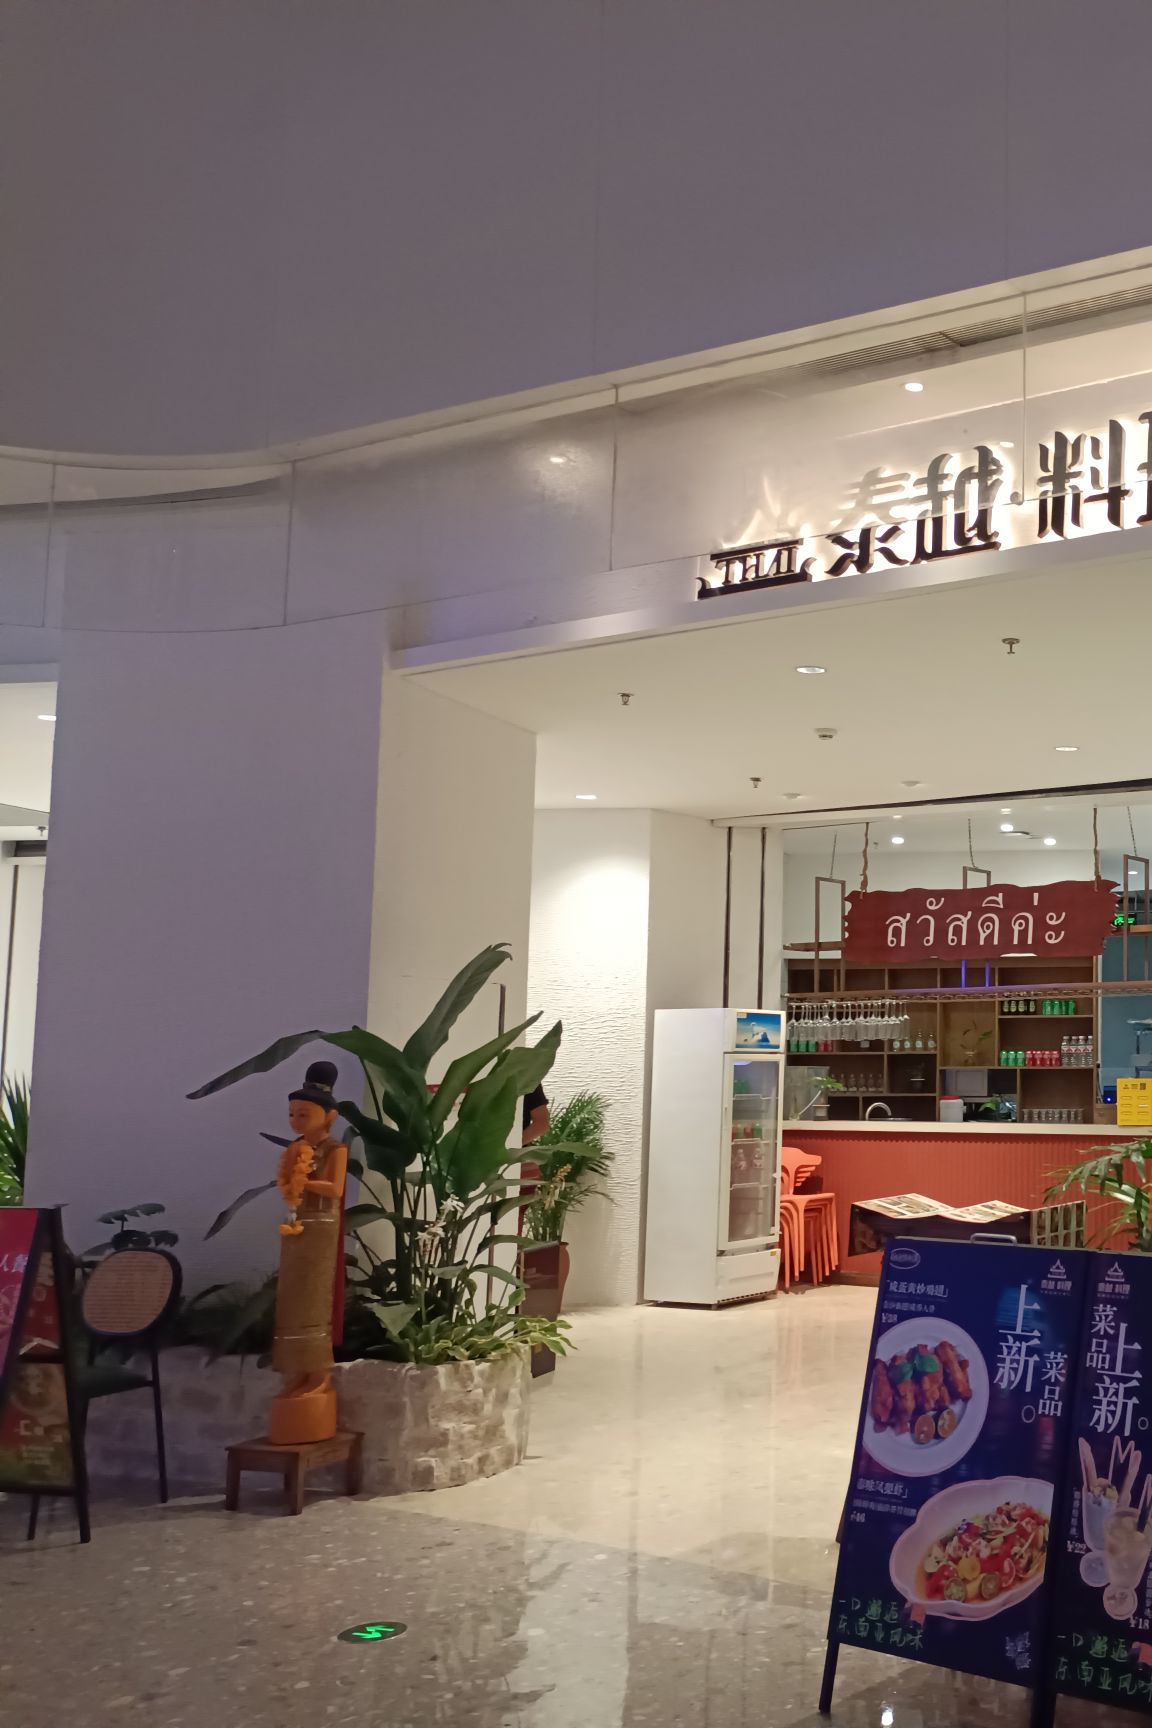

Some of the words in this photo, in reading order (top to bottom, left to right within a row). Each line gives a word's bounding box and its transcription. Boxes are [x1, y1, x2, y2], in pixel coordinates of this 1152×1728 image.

[886, 892, 1066, 947] สวัสดีค่ะ
[1086, 1304, 1117, 1368] 菜品
[1038, 1351, 1068, 1417] 菜品
